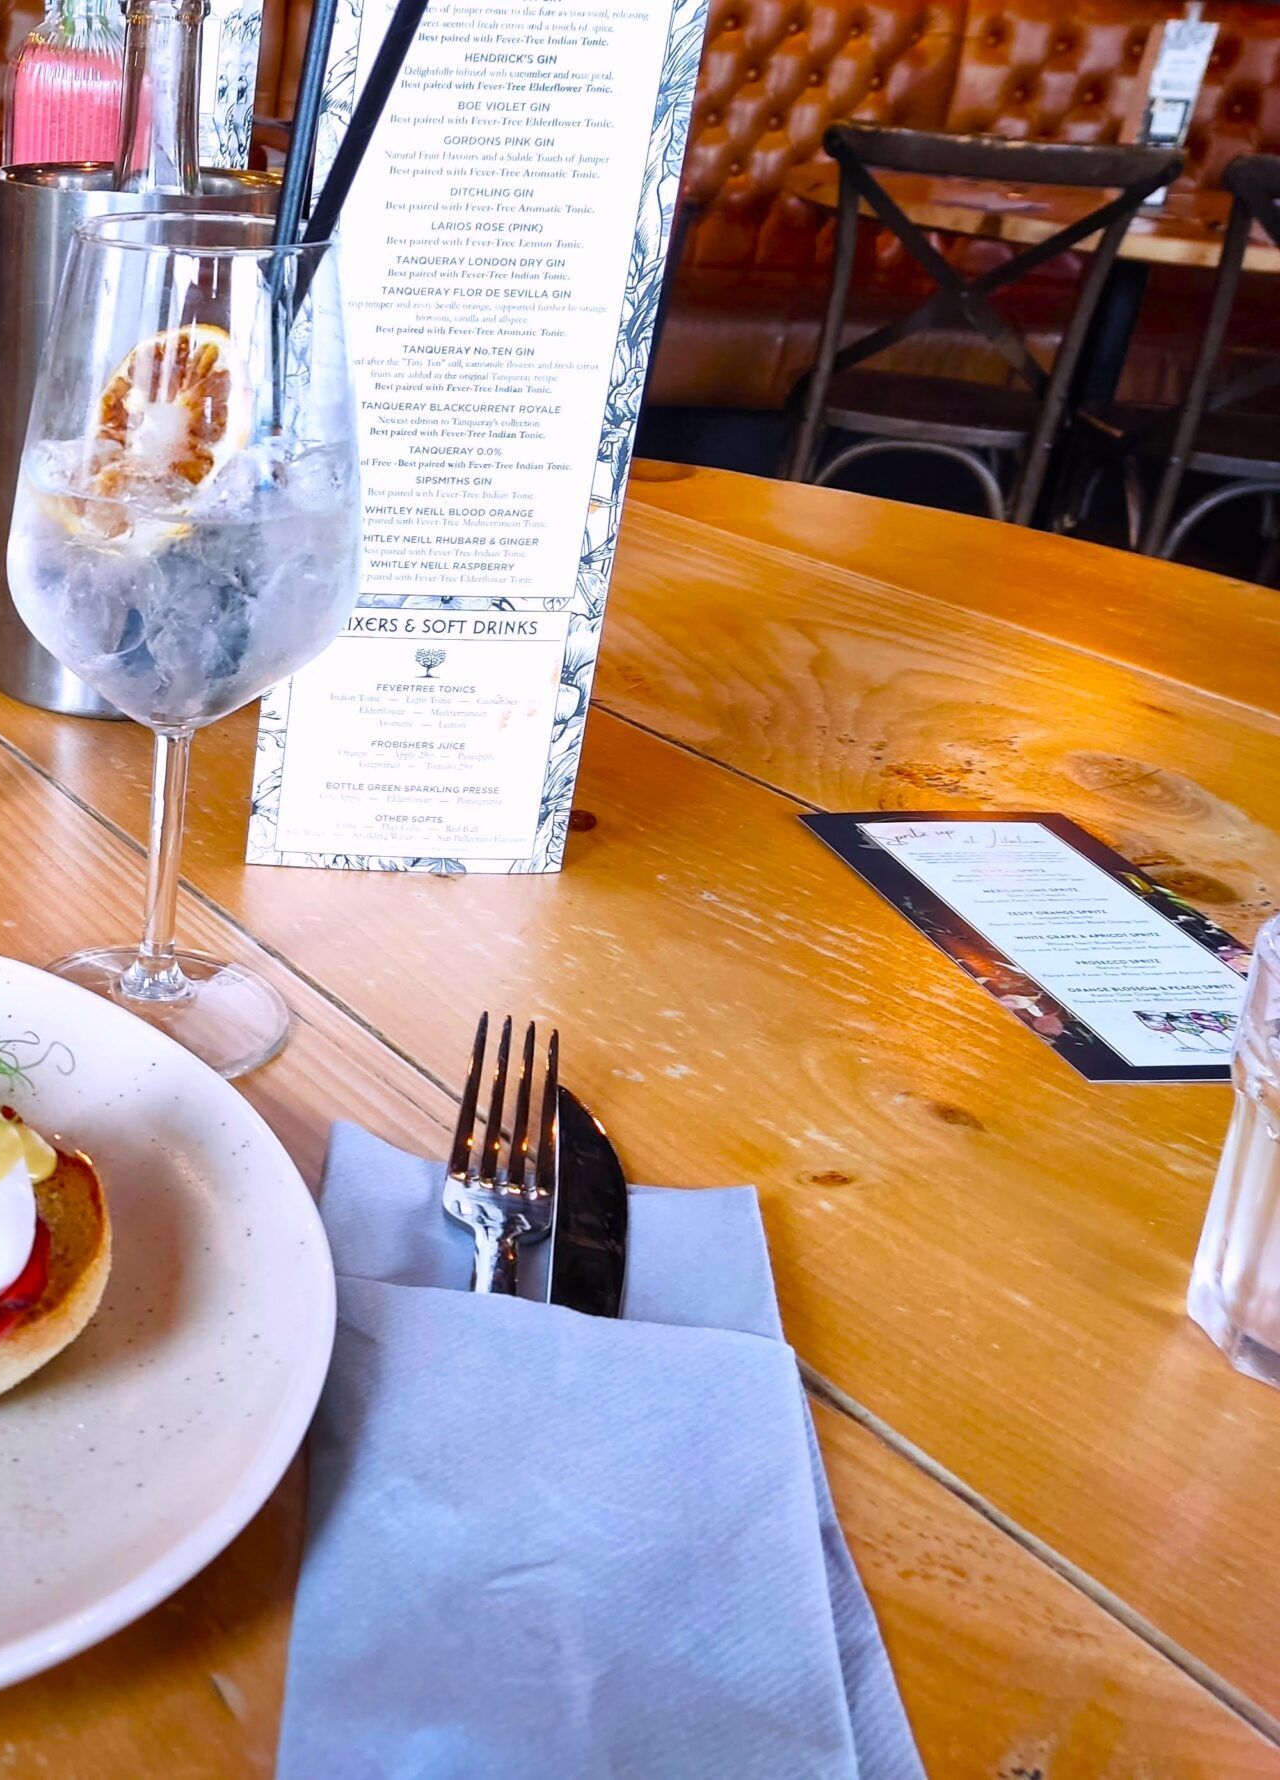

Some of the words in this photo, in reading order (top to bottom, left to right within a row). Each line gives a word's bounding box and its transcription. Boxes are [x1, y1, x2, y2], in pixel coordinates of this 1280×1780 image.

[418, 33, 438, 42] Best
[441, 34, 471, 45] paired
[473, 34, 493, 43] with
[496, 35, 545, 45] Fever-Tree
[548, 36, 578, 45] Indian
[465, 53, 534, 64] HENDRICK'S
[537, 55, 558, 65] GIN
[401, 80, 421, 89] Best
[423, 80, 453, 92] paired
[455, 82, 475, 90] with
[477, 82, 526, 91] Fever-Tree
[458, 101, 482, 111] BOE
[486, 102, 527, 112] VIOLET
[530, 103, 551, 112] GIN
[390, 114, 411, 123] Best
[413, 115, 445, 127] paired
[448, 116, 468, 125] with
[471, 116, 523, 126] Fever-Tree
[444, 136, 501, 146] GORDONS
[505, 137, 532, 147] PINK
[535, 138, 555, 147] GIN
[390, 165, 410, 175] Best
[412, 167, 443, 178] paired
[446, 168, 467, 176] with
[470, 168, 521, 177] Fever-Tree
[523, 169, 568, 178] Aromatic
[450, 188, 511, 198] DITCHLING
[514, 189, 534, 198] GIN
[385, 201, 406, 210] Best
[409, 202, 439, 213] paired
[442, 203, 463, 212] with
[466, 203, 516, 212] Fever-Tree
[518, 204, 563, 213] Aromatic
[431, 222, 472, 231] LARIOS
[475, 222, 505, 232] ROSE
[508, 223, 544, 234] (PINK)
[387, 236, 407, 245] Best
[409, 237, 440, 248] paired
[442, 237, 463, 246] with
[466, 238, 516, 248] Fever-Tree
[519, 239, 552, 248] Lemon
[396, 256, 466, 266] TANQUERAY
[468, 258, 517, 267] LONDON
[520, 258, 543, 267] DRY
[546, 259, 566, 268] GIN
[388, 269, 407, 277] Best
[408, 270, 438, 280] paired
[440, 270, 459, 278] with
[461, 270, 508, 280] Fever-Tree
[511, 271, 540, 280] Indian
[382, 287, 451, 296] TANQUERAY
[453, 288, 483, 297] FLOR
[486, 289, 500, 298] DE
[504, 289, 549, 299] SEVILLA
[552, 290, 572, 299] GIN
[376, 325, 395, 333] Best
[397, 326, 425, 336] paired
[427, 326, 446, 335] with
[448, 327, 495, 336] Fever-Tree
[497, 328, 537, 337] Aromatic
[403, 345, 472, 355] TANQUERAY
[474, 347, 513, 356] No.TEN
[516, 348, 535, 356] GIN
[375, 382, 394, 391] Best
[395, 383, 423, 393] paired
[446, 384, 493, 393] Fever-Tree
[495, 385, 523, 393] Indian
[361, 402, 427, 411] TANQUERAY
[430, 403, 516, 413] BLACKCURRENT
[519, 405, 562, 414] ROYALE
[370, 427, 389, 436] Best
[390, 428, 418, 438] paired
[420, 429, 439, 437] with
[441, 429, 486, 438] Fever-Tree
[488, 430, 517, 439] Indian
[409, 446, 474, 455] TANQUERAY
[477, 448, 502, 456] 0.0%
[372, 458, 392, 467] Free
[418, 460, 446, 470] paired
[447, 461, 466, 469] with
[468, 461, 514, 470] Fever-Tree
[516, 462, 544, 470] Indian
[416, 476, 470, 486] SIPSMITHS
[473, 478, 492, 486] GIN
[365, 506, 413, 515] WHITLEY
[416, 508, 445, 516] NEILL
[449, 508, 486, 517] BLOOD
[489, 509, 535, 518] ORANGE
[363, 534, 400, 543] HITLEY
[403, 536, 432, 544] NEILL
[435, 536, 487, 546] RHUBARB
[489, 537, 496, 545] &
[499, 538, 539, 546] GINGER
[371, 560, 418, 569] WHITLEY
[420, 562, 450, 570] NEILL
[453, 562, 515, 571] RASPBERRY
[346, 617, 398, 633] IXERS
[405, 619, 416, 633] &
[422, 619, 468, 634] SOFT
[473, 621, 538, 635] DRINKS
[376, 684, 435, 693] FEVERTREE
[438, 685, 476, 694] TONICS
[371, 740, 435, 750] FROBISHERS
[326, 782, 365, 791] BOTTLE
[367, 784, 401, 792] GREEN
[404, 784, 460, 794] SPARKLING
[462, 787, 500, 795] PRESSE
[375, 815, 409, 823] OTHER
[412, 816, 443, 824] SOFTS
